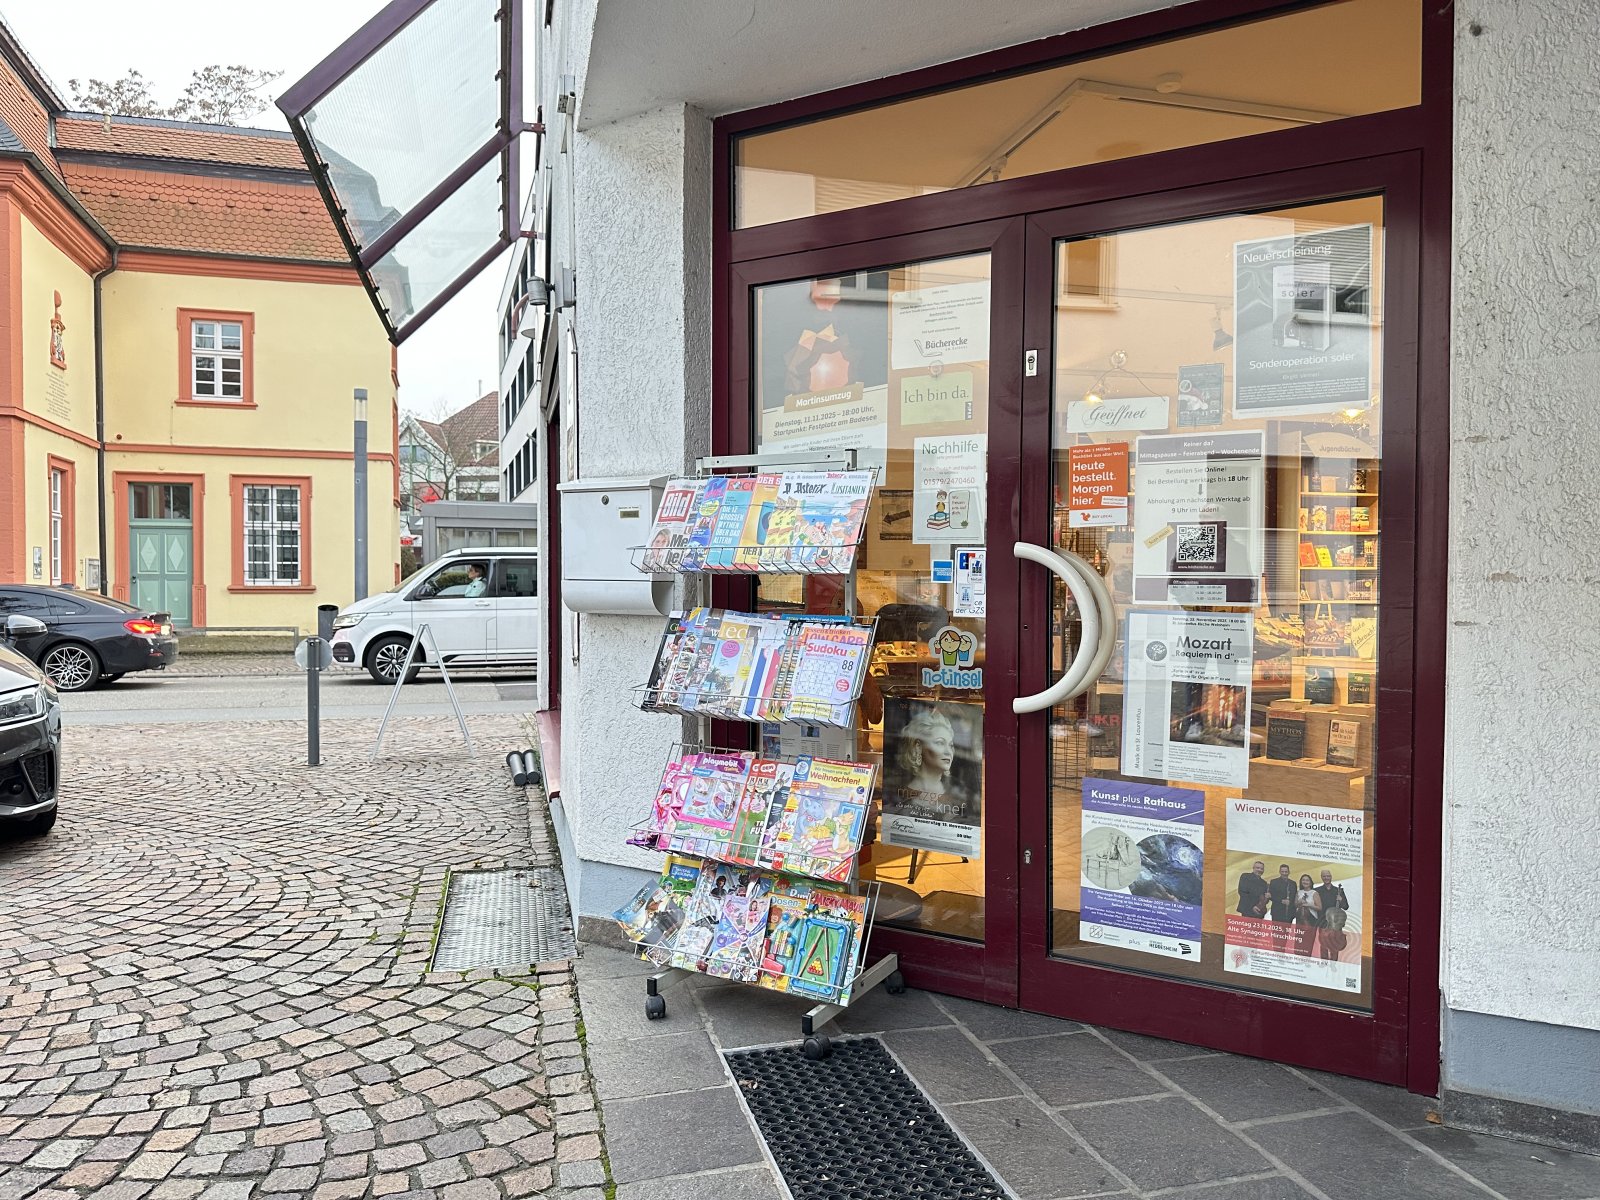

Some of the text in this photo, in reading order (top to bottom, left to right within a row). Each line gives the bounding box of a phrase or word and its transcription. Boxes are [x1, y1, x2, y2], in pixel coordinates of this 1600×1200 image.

[1243, 244, 1332, 264] Neuerscheinung
[925, 336, 968, 349] Bücherecke
[1249, 352, 1355, 370] Sonderoperation soler
[796, 391, 852, 408] Martinsumzug
[904, 385, 969, 404] Ich bin da.
[804, 412, 836, 423] 11.11.2025
[842, 408, 860, 417] 18:00
[1083, 404, 1147, 426] Geöffnet
[774, 424, 808, 437] Startpunkt:
[808, 422, 836, 432] Festplatz
[849, 414, 878, 424] Badesee
[922, 440, 978, 454] Nachhilfe
[1073, 461, 1105, 471] Heute
[924, 477, 976, 485] 01579/2470460
[1073, 472, 1116, 482] bestellt.
[794, 482, 866, 494] Asterix LUSITANIEN
[1073, 485, 1113, 495] Morgen
[662, 492, 692, 517] Bild
[1073, 496, 1094, 505] hier.
[670, 534, 688, 547] Me
[806, 642, 847, 656] Sudoku
[1176, 636, 1232, 650] Mozart
[842, 660, 854, 671] 88
[924, 669, 982, 687] notinsel
[703, 758, 739, 767] playmobil
[810, 772, 860, 785] Weihnachten!
[1091, 789, 1186, 810] Kunst plus Rathaus
[936, 800, 967, 816] knef
[1234, 803, 1361, 824] Wiener Oboenquartette
[1288, 820, 1361, 836] Die Goldene Ära
[772, 896, 800, 906] Dosen-
[1227, 919, 1252, 928] Sonntag
[1241, 928, 1269, 938] Synagoge
[1270, 932, 1302, 943] Hirschberg
